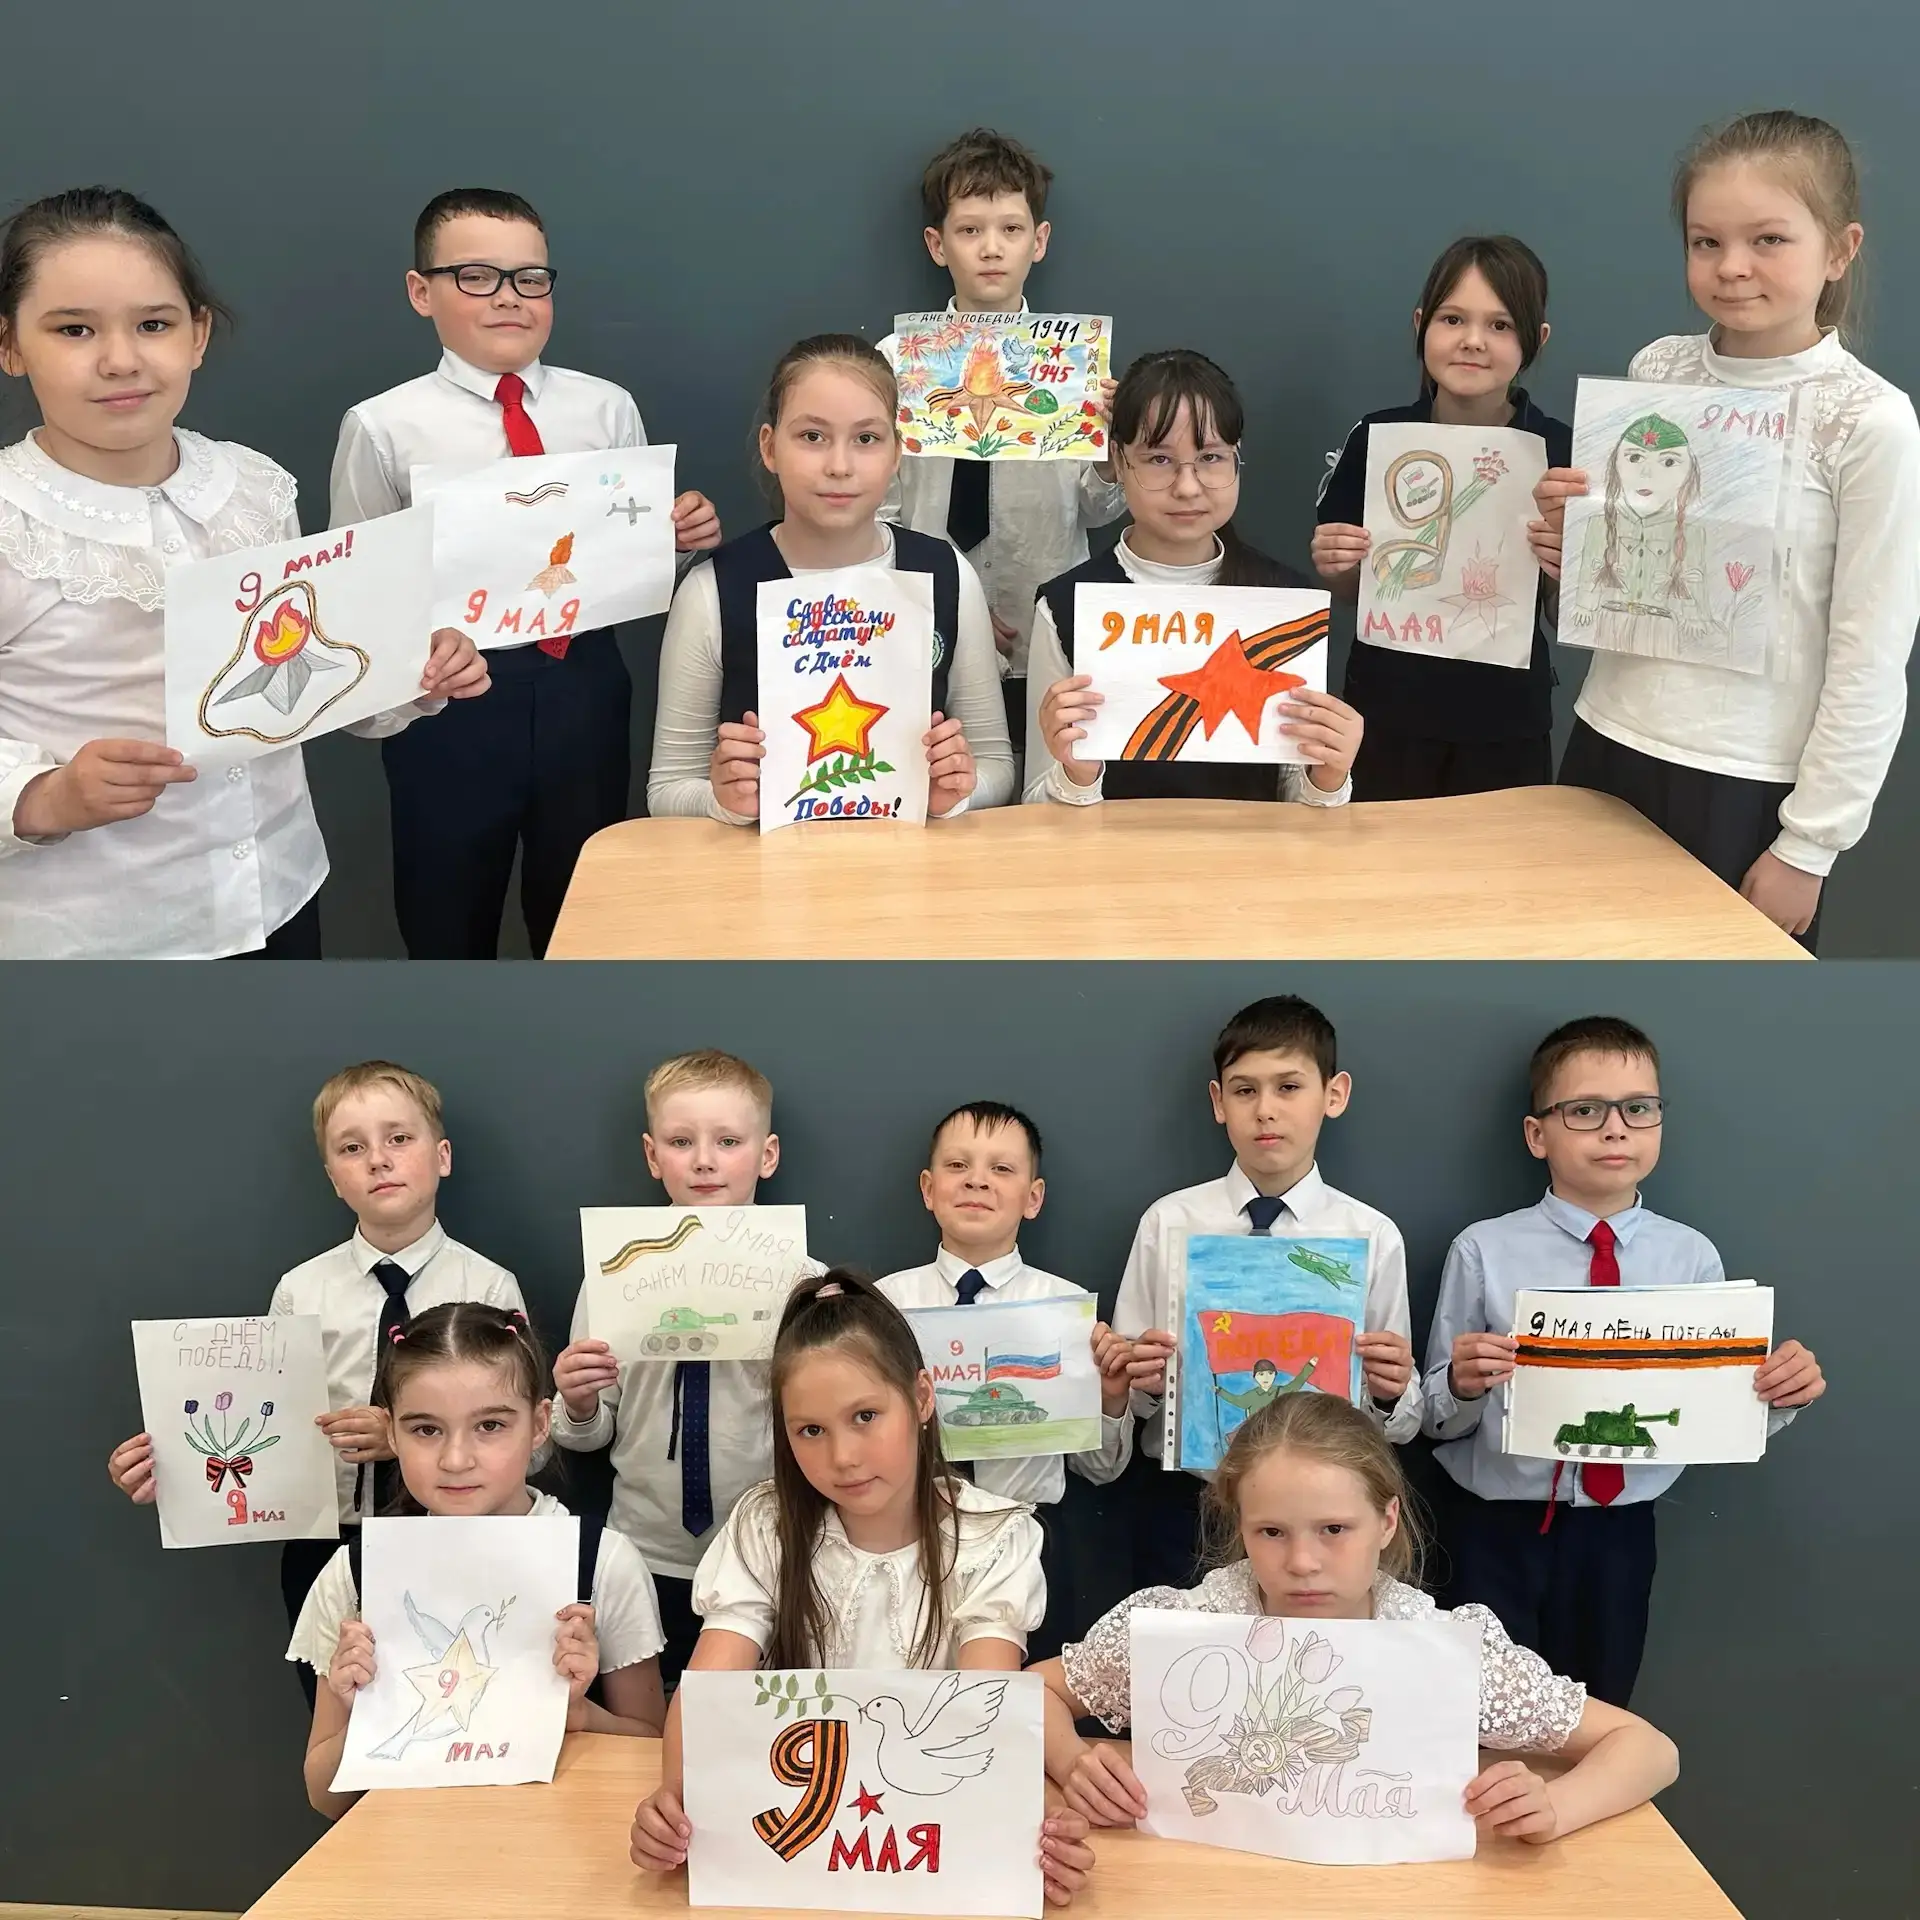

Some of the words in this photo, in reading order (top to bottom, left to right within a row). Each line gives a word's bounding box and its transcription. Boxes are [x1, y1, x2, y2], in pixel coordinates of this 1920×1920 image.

[907, 313, 917, 322] С
[960, 313, 1022, 325] ПОБЕДЫ!
[1029, 320, 1081, 343] 1941
[1084, 319, 1103, 343] 9
[1027, 364, 1076, 383] 1945
[1086, 348, 1099, 392] МАЯ
[1698, 404, 1723, 430] 9
[1720, 407, 1786, 440] МАЯ
[235, 572, 262, 613] 9
[786, 594, 848, 619] Слава
[464, 589, 488, 624] 9
[494, 598, 580, 636] МАЯ
[799, 610, 896, 634] русскому
[1363, 608, 1444, 644] МАЯ
[1099, 611, 1126, 651] 9
[1132, 610, 1215, 646] МАЯ
[794, 795, 902, 822] Победы!
[738, 1228, 794, 1261] МАЯ
[173, 1323, 187, 1342] С
[210, 1318, 277, 1345] ДНЁМ
[1529, 1311, 1546, 1337] 9
[1552, 1317, 1592, 1339] МАЯ
[1602, 1318, 1651, 1340] ДЕНЬ
[1662, 1325, 1736, 1341] ПОБЕДЫ
[178, 1340, 287, 1374] ПОБЕДЫ!
[949, 1339, 964, 1356] 9
[932, 1363, 981, 1382] МАЯ
[227, 1489, 248, 1525] 9
[438, 1669, 460, 1699] 9
[1150, 1644, 1250, 1761] 9
[445, 1742, 510, 1763] МАЯ
[752, 1719, 849, 1862] 9
[1276, 1762, 1418, 1819] Мая
[827, 1823, 941, 1874] МАЯ
